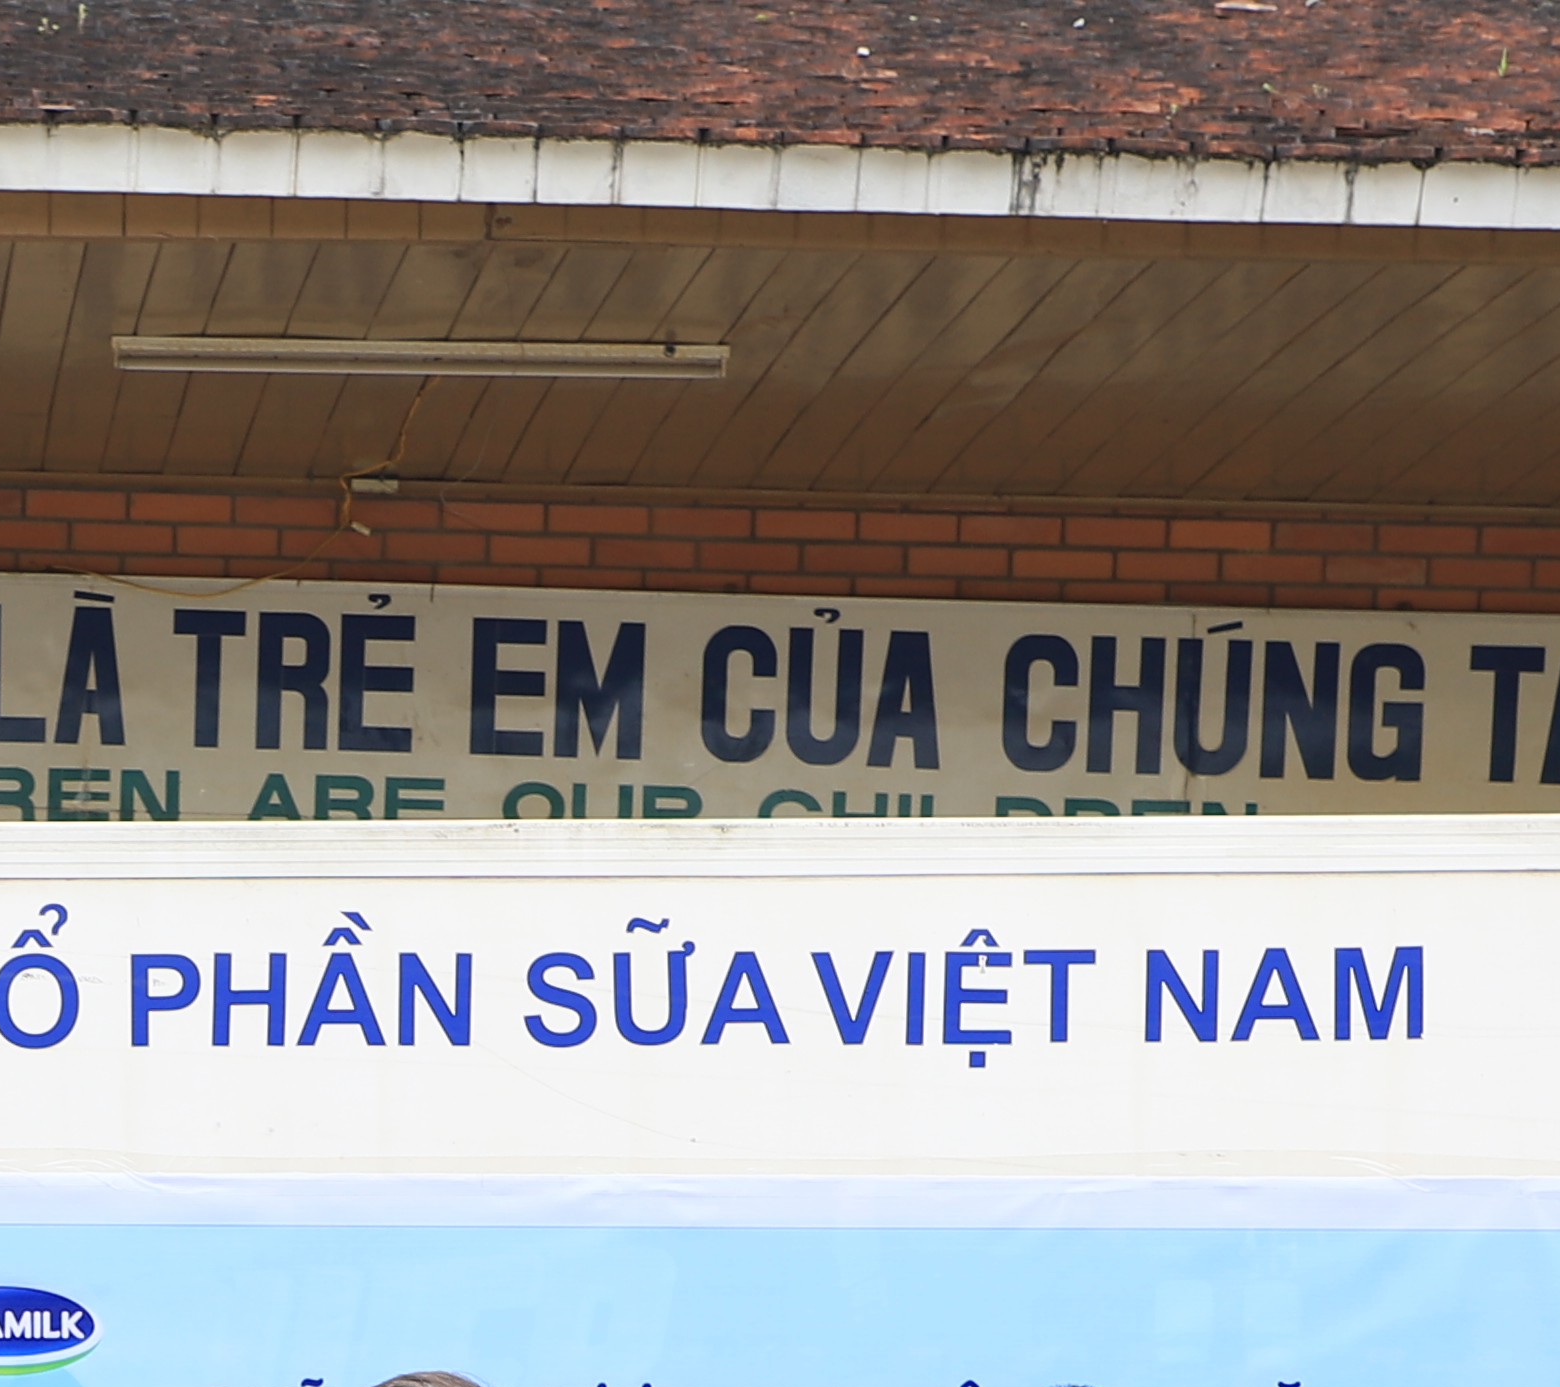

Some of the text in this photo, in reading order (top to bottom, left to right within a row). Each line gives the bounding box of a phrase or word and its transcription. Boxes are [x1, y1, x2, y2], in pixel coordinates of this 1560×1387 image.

[174, 594, 413, 754] TRẺ
[470, 617, 646, 759] EM
[702, 608, 940, 770] CỦA
[1004, 620, 1426, 782] CHÚNG
[247, 772, 448, 822] ARE
[130, 911, 472, 1048] PHẦN
[525, 917, 789, 1048] SỮA
[812, 927, 1095, 1067] VIỆT
[1145, 945, 1425, 1041] NAM
